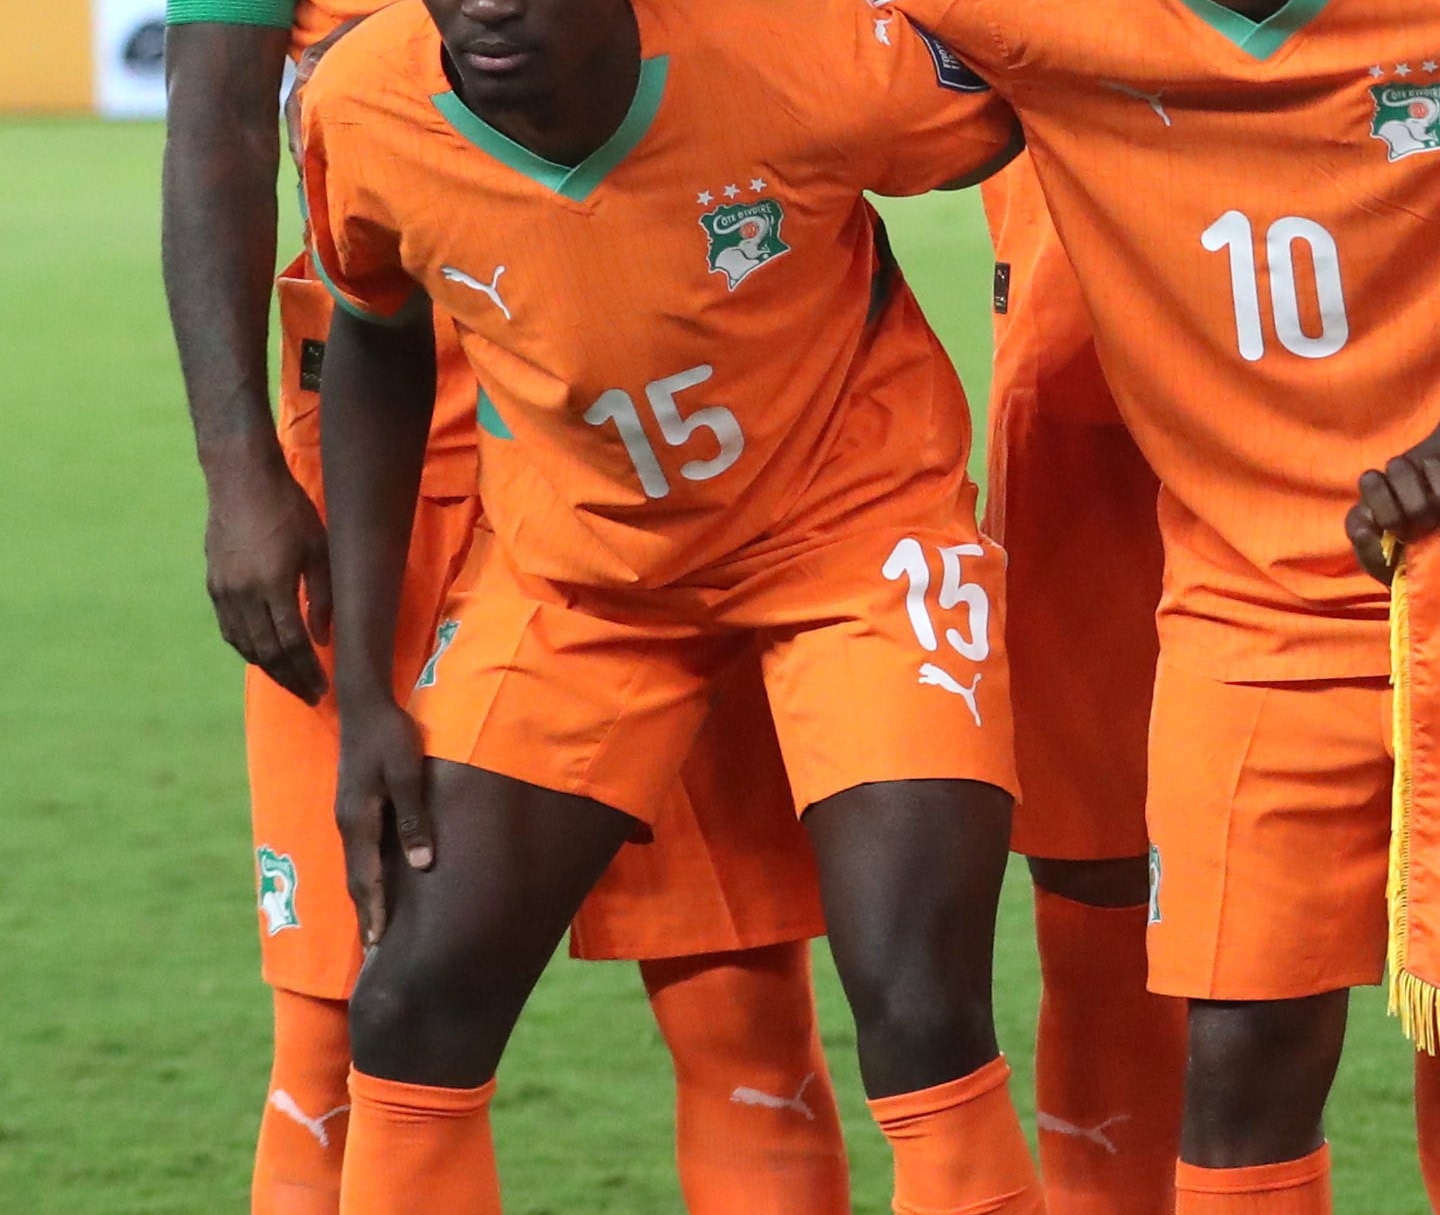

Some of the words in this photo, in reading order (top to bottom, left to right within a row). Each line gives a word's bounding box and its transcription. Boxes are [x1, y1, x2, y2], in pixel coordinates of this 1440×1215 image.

[1201, 209, 1350, 362] 10
[584, 364, 745, 499] 15
[881, 538, 990, 662] 15
